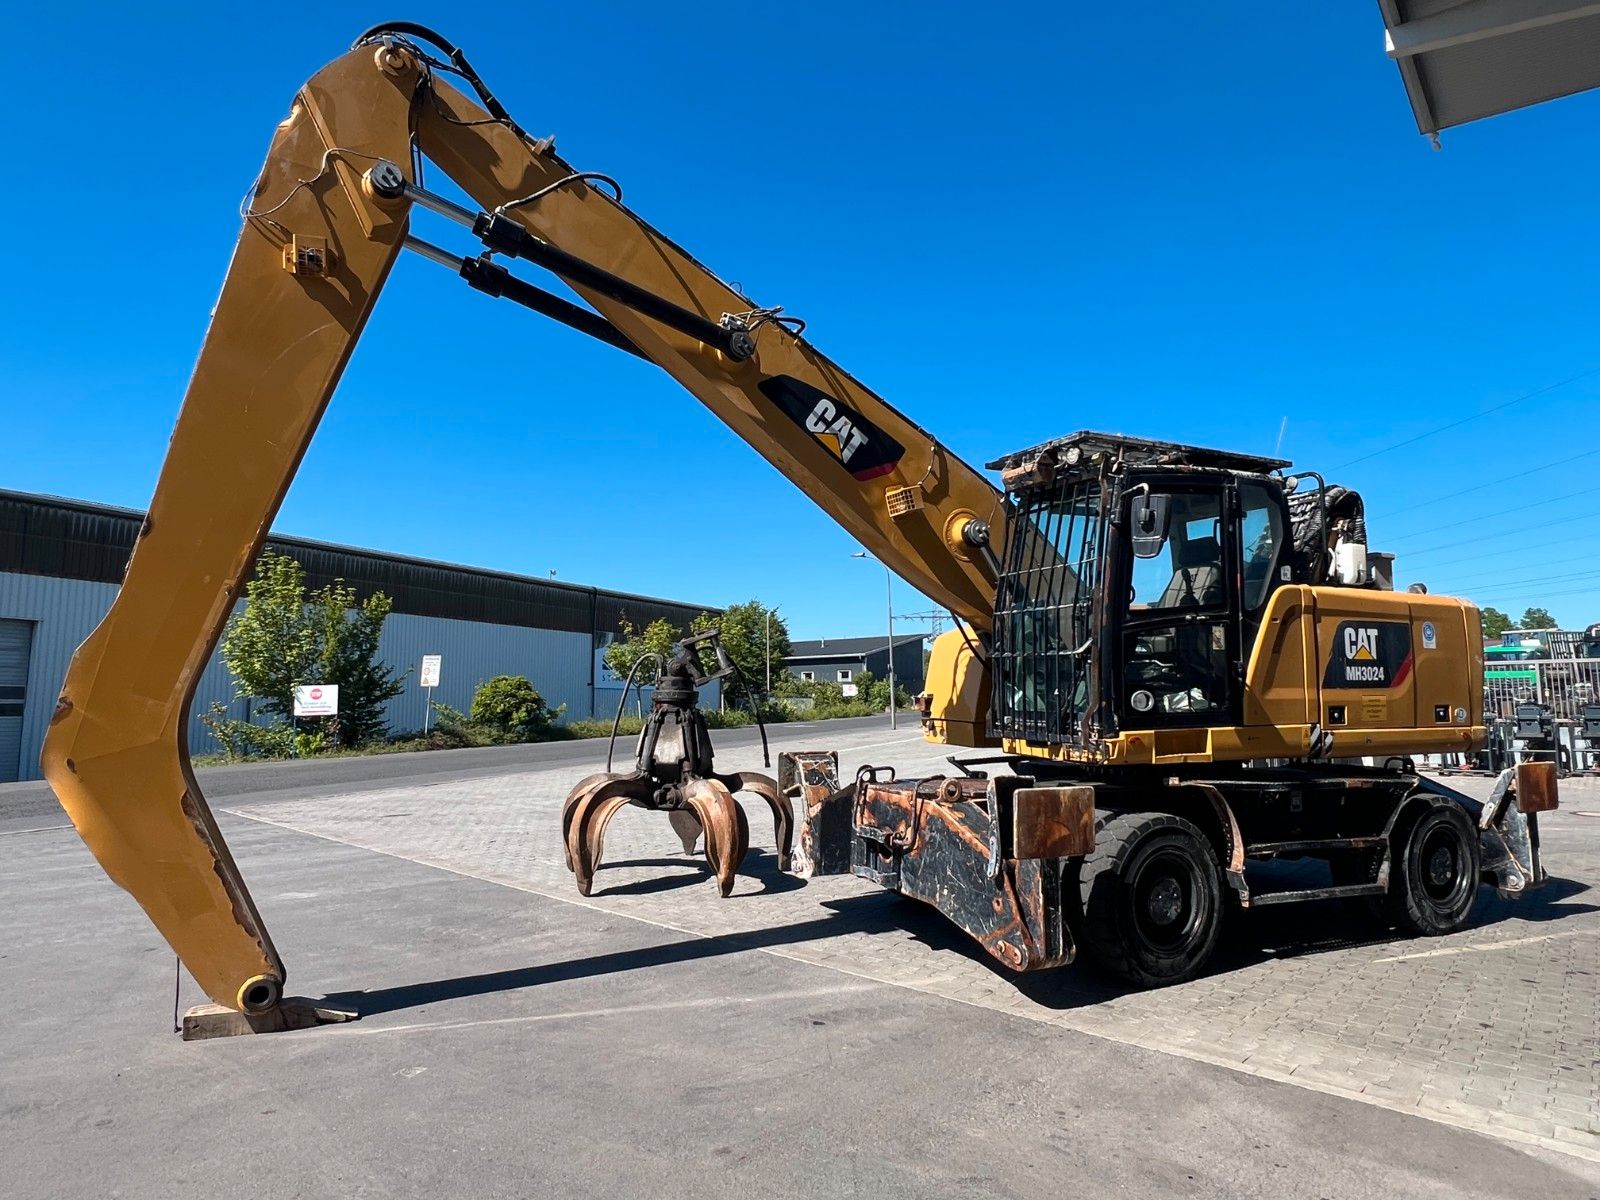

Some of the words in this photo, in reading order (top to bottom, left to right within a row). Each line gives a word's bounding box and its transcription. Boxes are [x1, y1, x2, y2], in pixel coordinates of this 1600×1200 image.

[805, 398, 869, 464] CAT
[1344, 627, 1378, 660] CAT
[1346, 666, 1385, 681] MH3024
